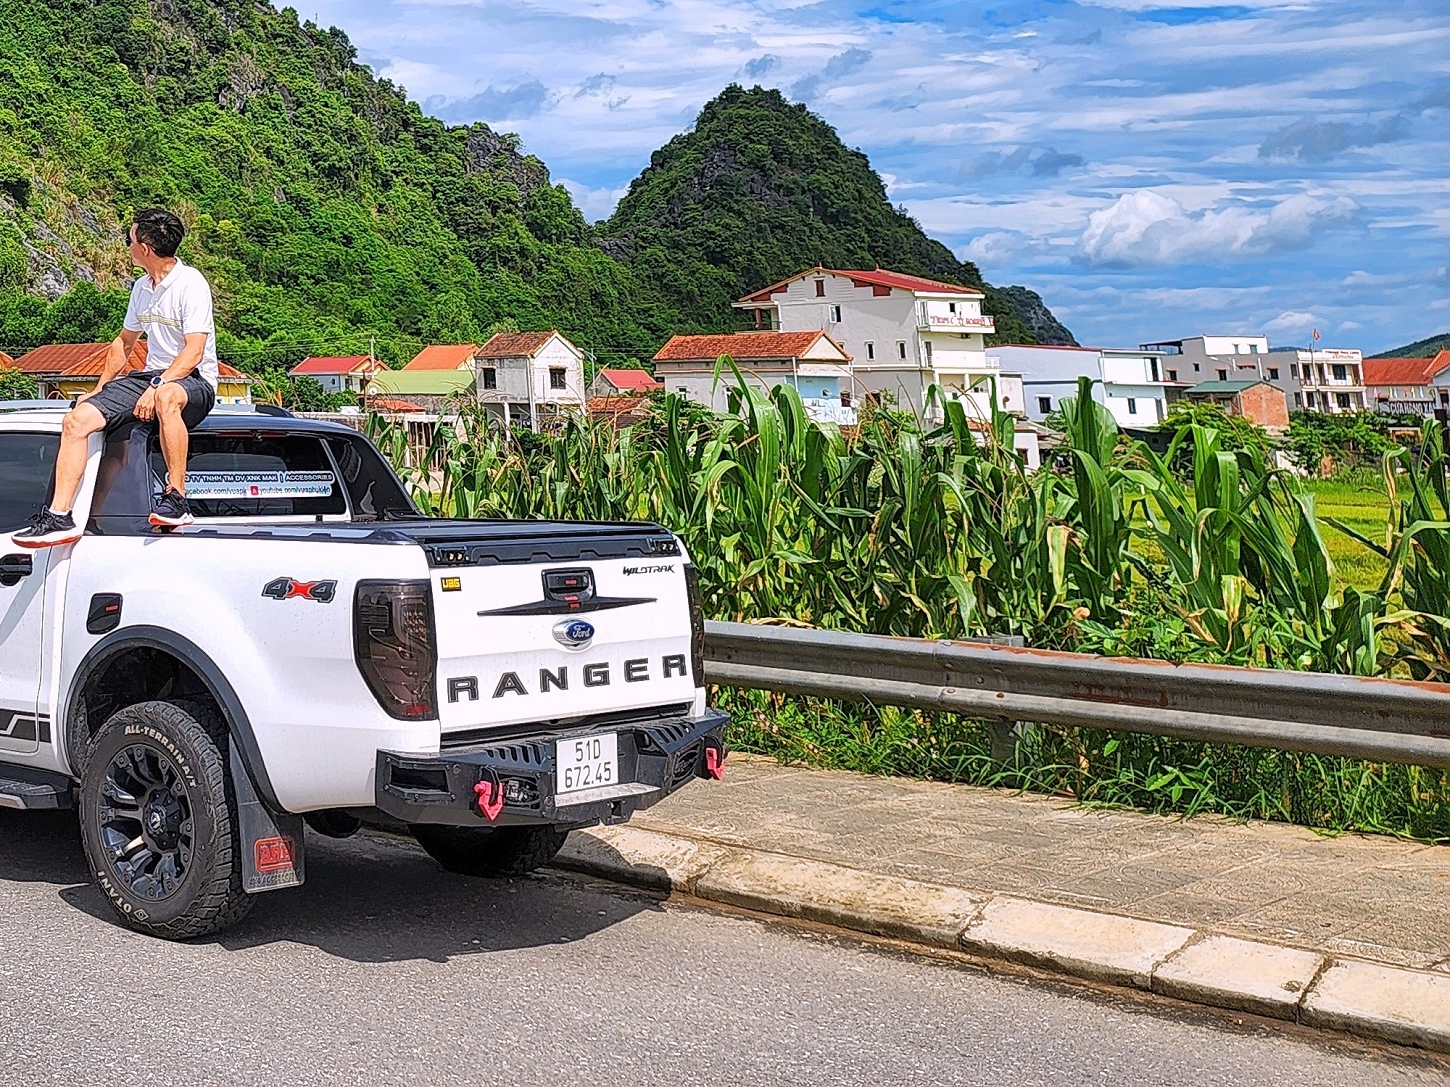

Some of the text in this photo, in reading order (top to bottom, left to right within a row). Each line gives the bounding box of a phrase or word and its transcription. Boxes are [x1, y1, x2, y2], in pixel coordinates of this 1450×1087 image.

[623, 564, 675, 575] WILDTRAK
[572, 624, 591, 638] Ford
[447, 653, 688, 703] RANGER
[124, 724, 197, 788] ALL-TERRAIN A/T
[575, 738, 601, 762] 51D
[564, 761, 612, 789] 672.45
[97, 871, 132, 913] OTANI
